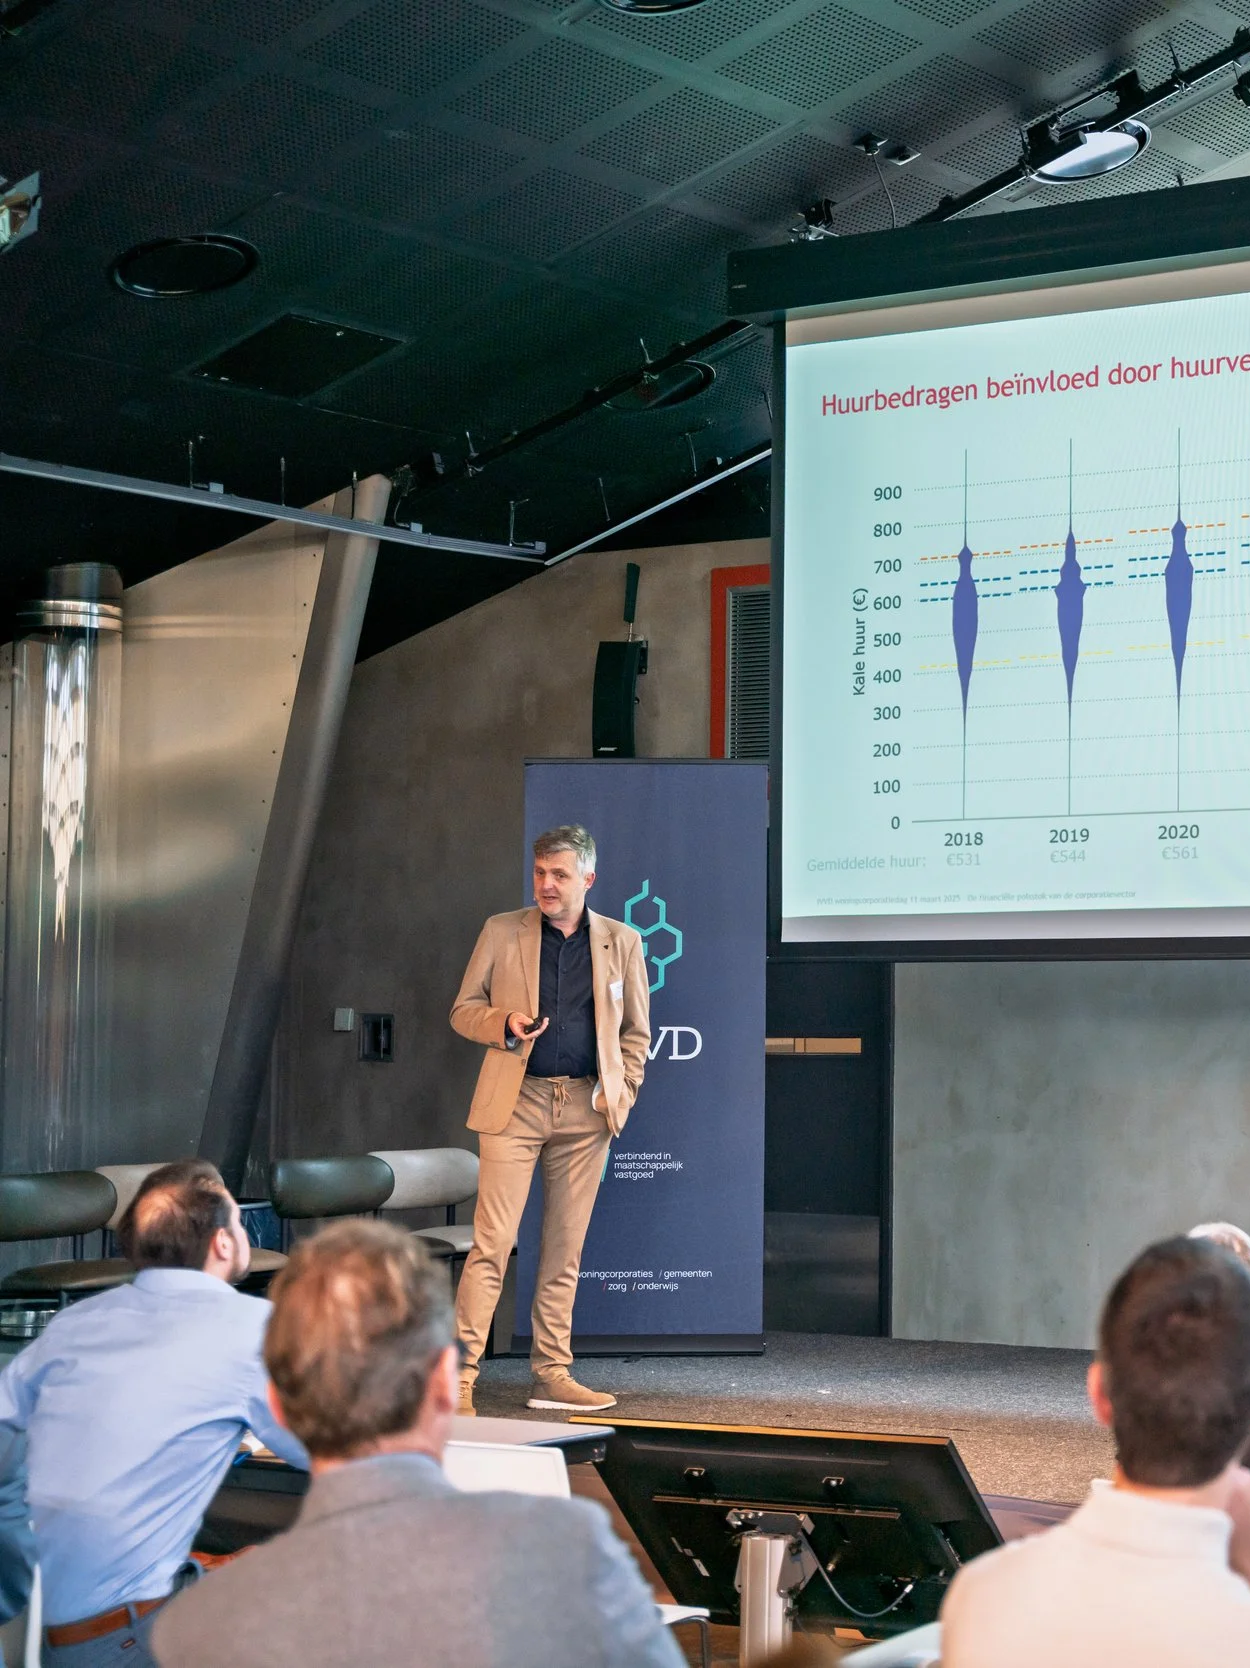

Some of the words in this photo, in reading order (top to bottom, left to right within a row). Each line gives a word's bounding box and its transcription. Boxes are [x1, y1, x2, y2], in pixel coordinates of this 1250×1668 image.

[822, 381, 977, 416] Huurbedragen
[987, 364, 1099, 400] beïnvloed
[1108, 361, 1163, 386] door
[873, 485, 902, 501] 900
[873, 522, 902, 538] 800
[873, 558, 902, 574] 700
[852, 588, 869, 612] (€)
[873, 595, 902, 610] 600
[852, 618, 866, 656] huur
[873, 632, 902, 647] 500
[852, 661, 866, 696] Kale
[873, 669, 902, 684] 400
[873, 706, 901, 720] 300
[873, 743, 901, 757] 200
[873, 779, 901, 794] 100
[891, 816, 901, 830] 0
[944, 832, 984, 847] 2018
[1049, 828, 1090, 844] 2019
[1157, 824, 1200, 840] 2020
[807, 857, 886, 872] Gemiddelde
[890, 854, 926, 868] huur:
[946, 853, 981, 867] €531
[1050, 849, 1086, 863] €544
[1161, 846, 1199, 860] €561
[647, 1026, 703, 1061] VD
[614, 1152, 662, 1161] verbindend
[663, 1151, 671, 1160] in
[614, 1160, 684, 1172] maatschappelijk
[614, 1170, 654, 1181] vastgoed
[663, 1269, 713, 1280] gemeenten
[607, 1282, 627, 1293] zorg
[637, 1281, 679, 1292] onderwijs
